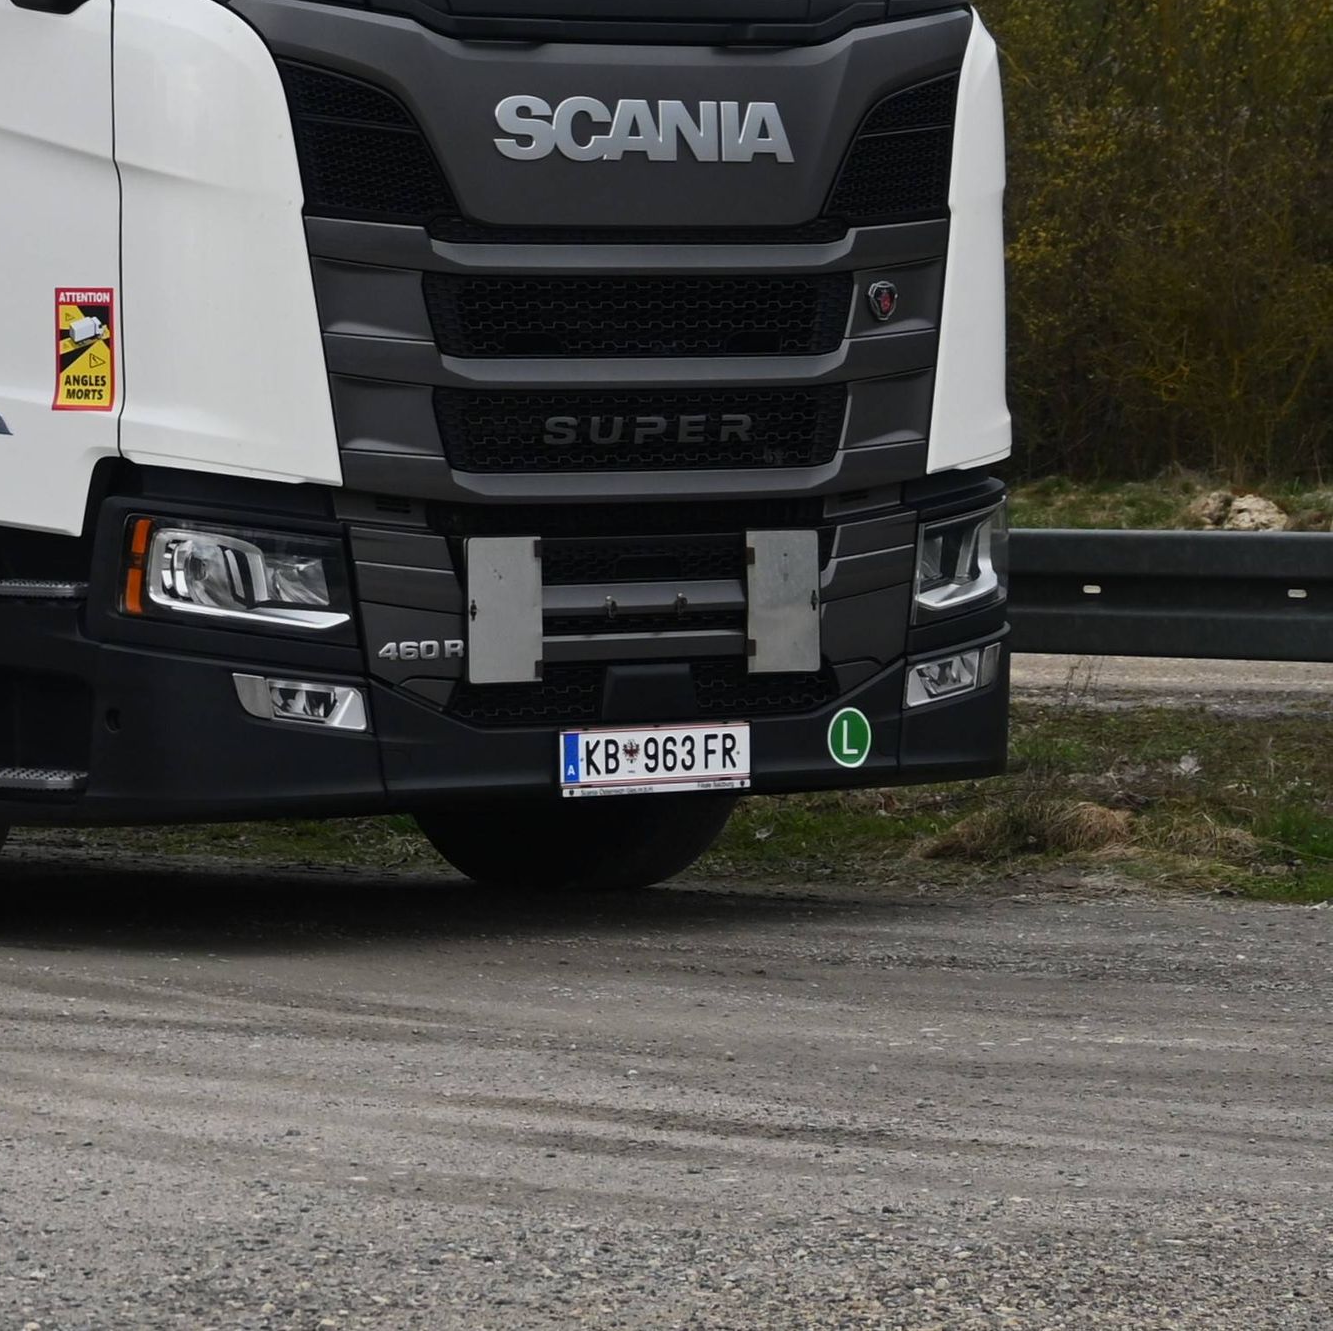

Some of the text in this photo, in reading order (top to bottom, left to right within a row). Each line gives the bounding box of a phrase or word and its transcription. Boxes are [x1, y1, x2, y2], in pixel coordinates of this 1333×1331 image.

[493, 95, 795, 163] SCANIA
[58, 291, 111, 303] ATTENTION
[64, 374, 107, 387] ANGLES
[65, 388, 104, 400] MORTS
[543, 414, 754, 445] SUPER
[378, 639, 465, 660] 460 R
[842, 720, 859, 755] L
[585, 733, 737, 776] KB 963 FR
[567, 764, 576, 777] A
